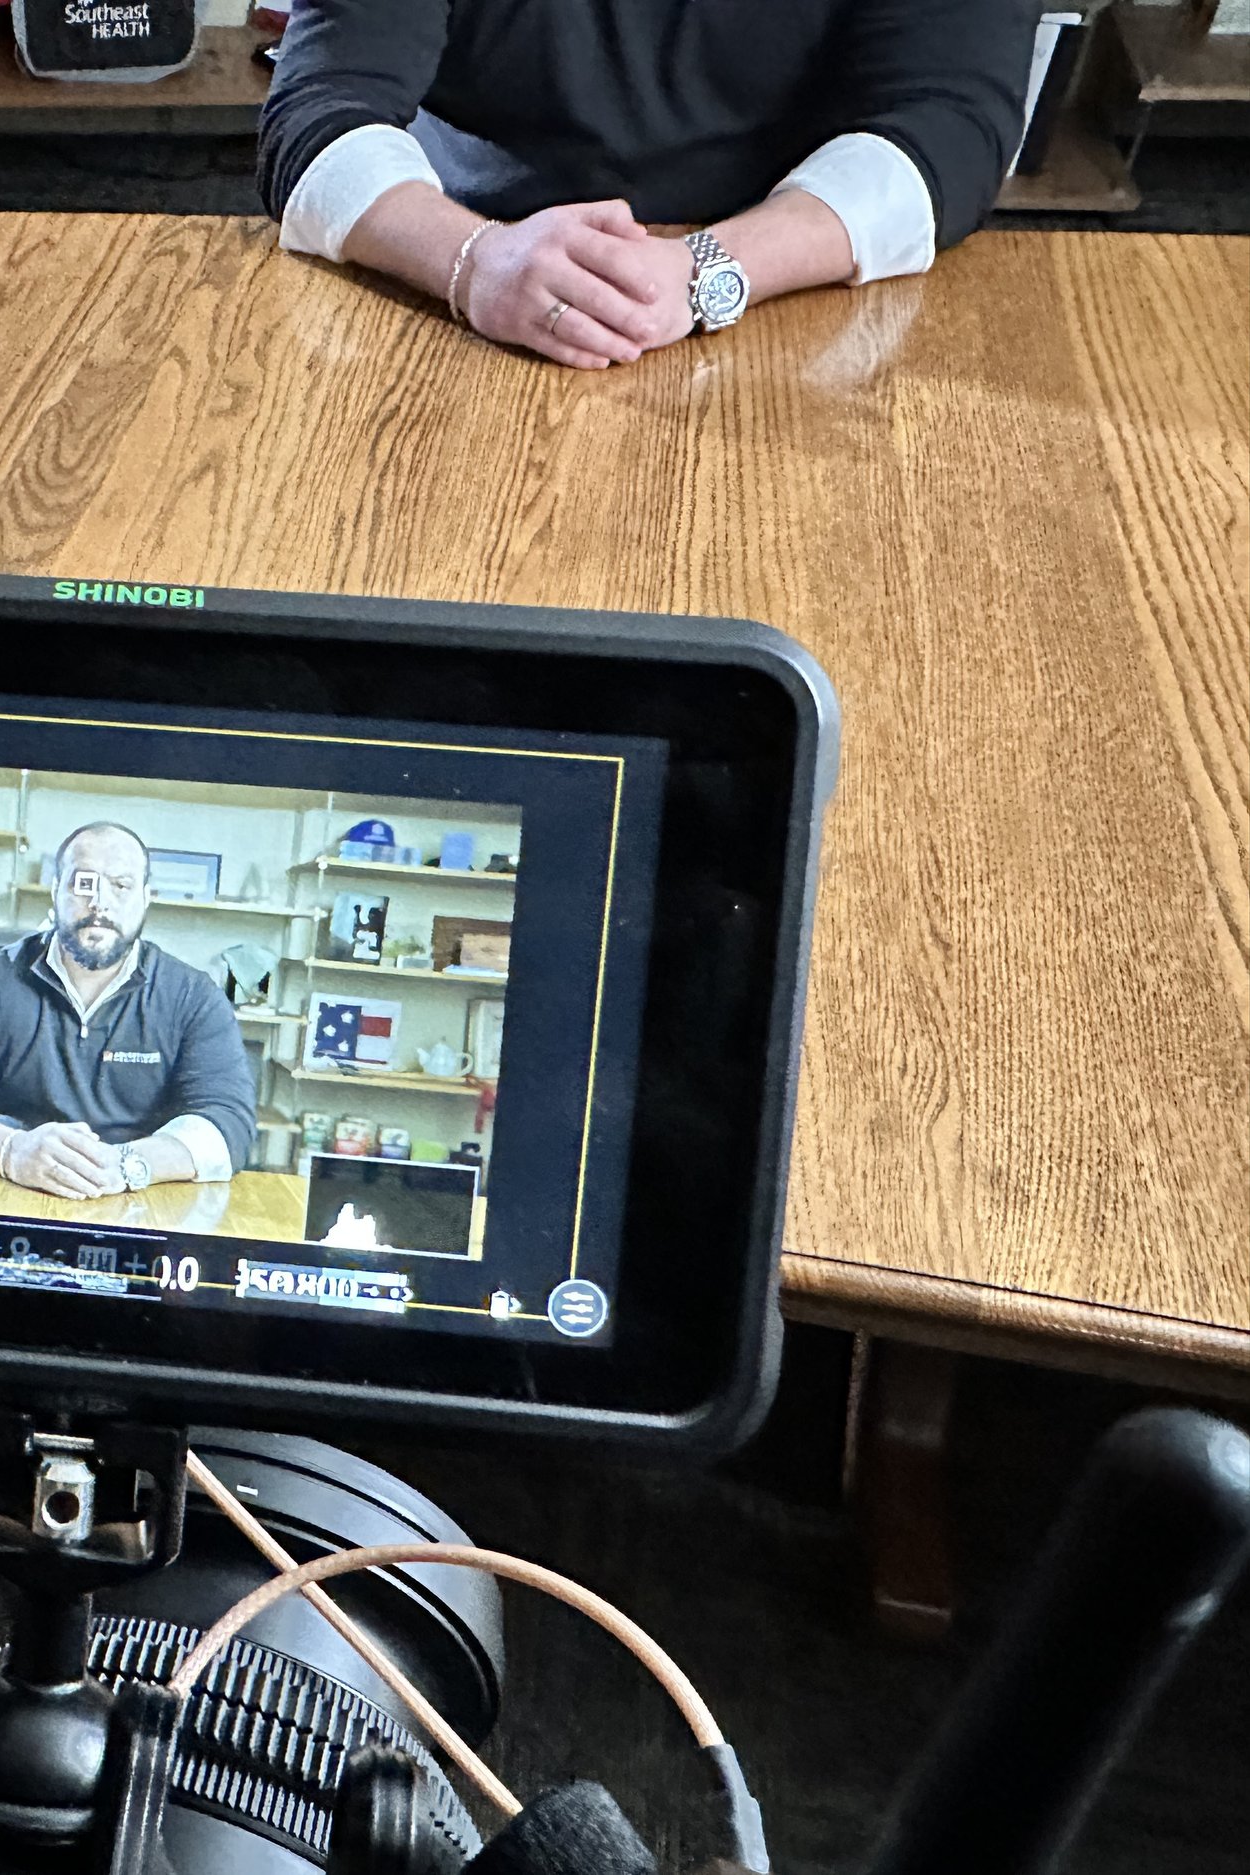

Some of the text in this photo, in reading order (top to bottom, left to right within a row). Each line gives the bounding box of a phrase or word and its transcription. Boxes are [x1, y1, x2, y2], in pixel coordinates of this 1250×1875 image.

[65, 3, 149, 24] Southeast
[92, 21, 150, 39] HEALTH
[52, 581, 205, 608] SHINOBI
